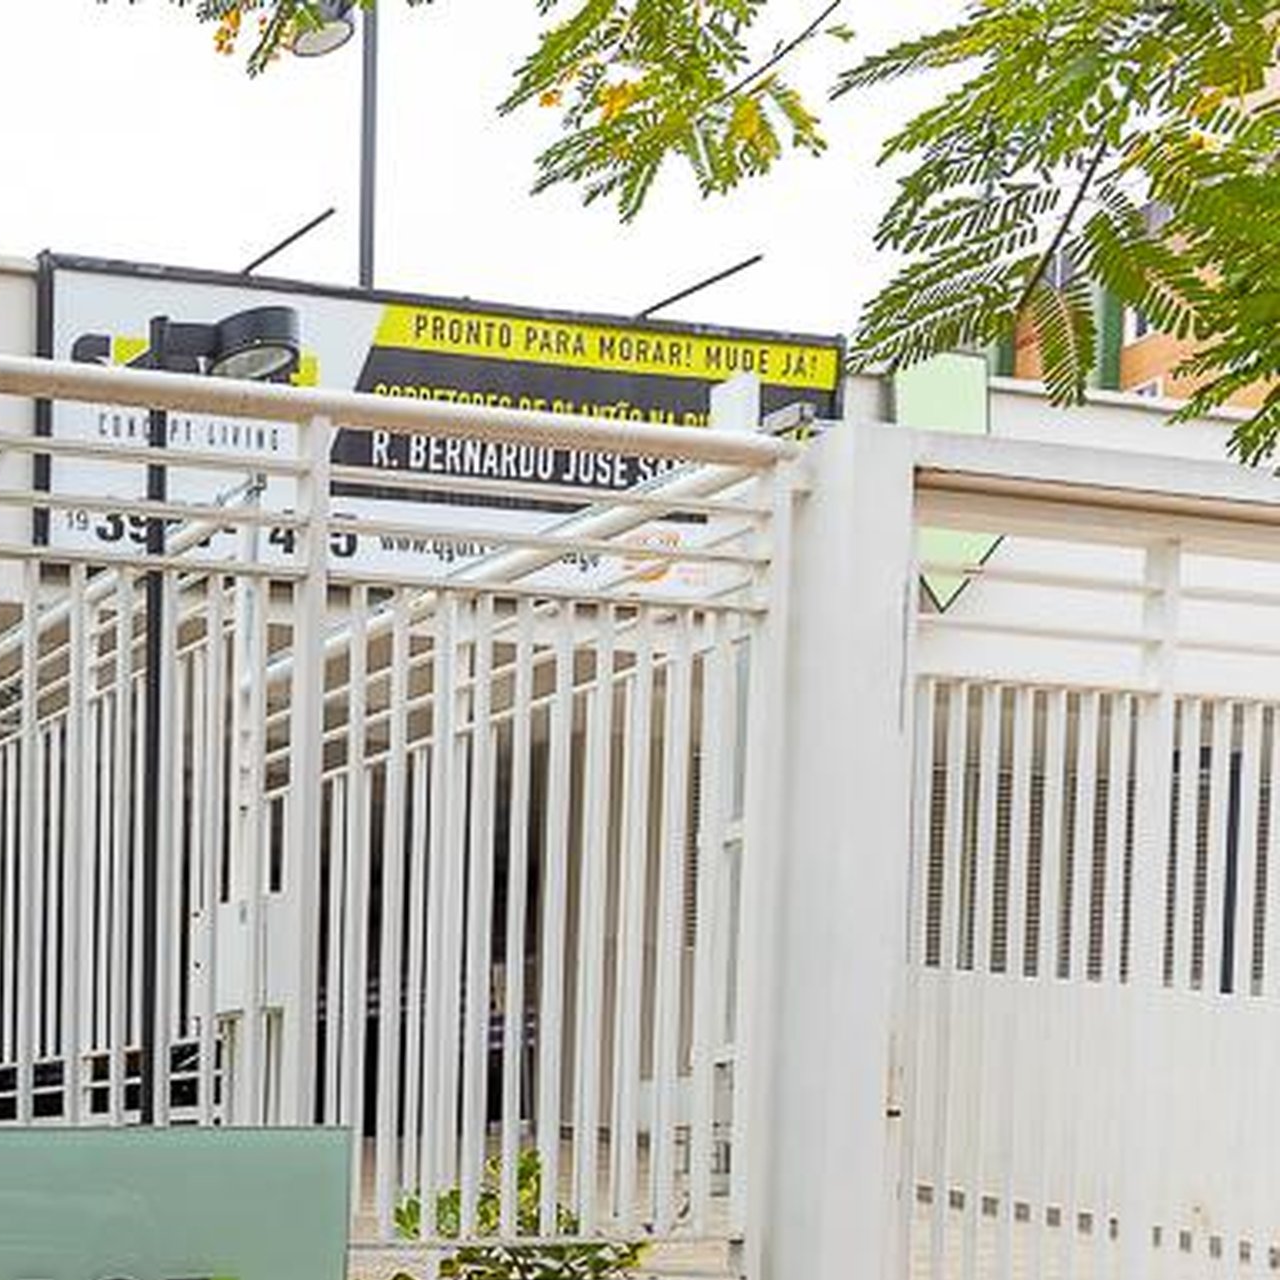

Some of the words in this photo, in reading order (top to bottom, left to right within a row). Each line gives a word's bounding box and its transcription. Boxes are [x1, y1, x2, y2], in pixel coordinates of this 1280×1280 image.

[413, 313, 513, 349] PRONTO
[525, 325, 585, 357] PARA
[598, 335, 693, 369] MORAR!
[705, 345, 769, 374] MUDE
[372, 429, 399, 467] R.
[408, 433, 555, 481] BERNARDO
[66, 508, 89, 531] 19
